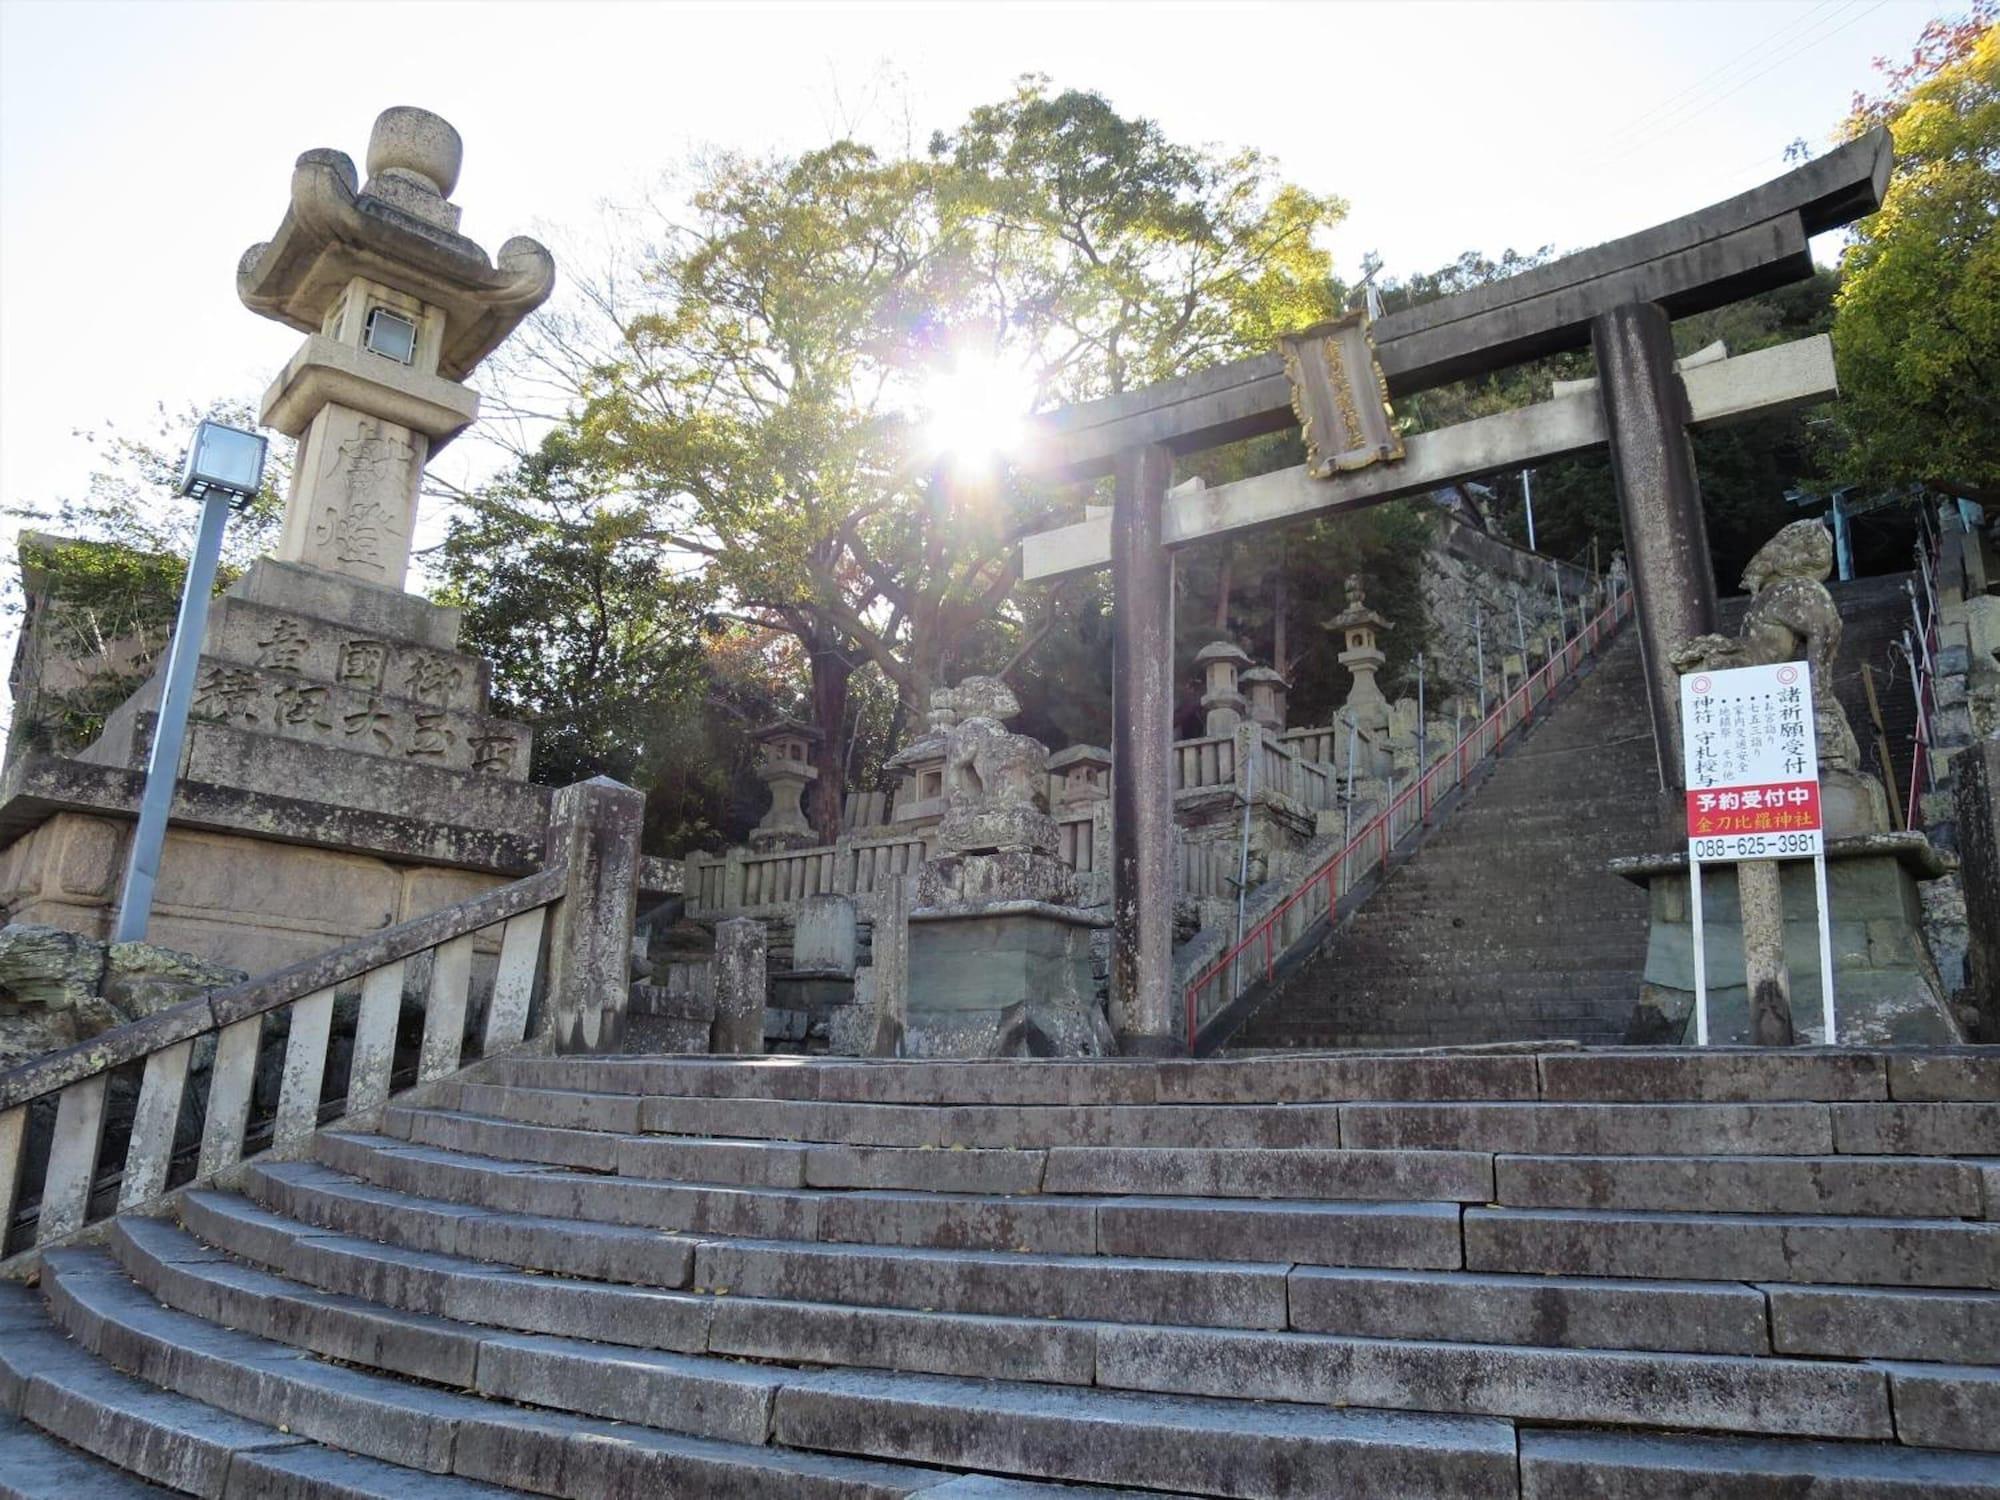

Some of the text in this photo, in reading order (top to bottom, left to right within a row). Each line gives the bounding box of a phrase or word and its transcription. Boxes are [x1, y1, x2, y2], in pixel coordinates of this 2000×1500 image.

[1777, 686, 1808, 774] 諸祈願受付
[1696, 788, 1810, 813] 予約受付中
[1695, 811, 1814, 834] 金刀比羅神社
[1695, 834, 1817, 858] 088-625-3981
